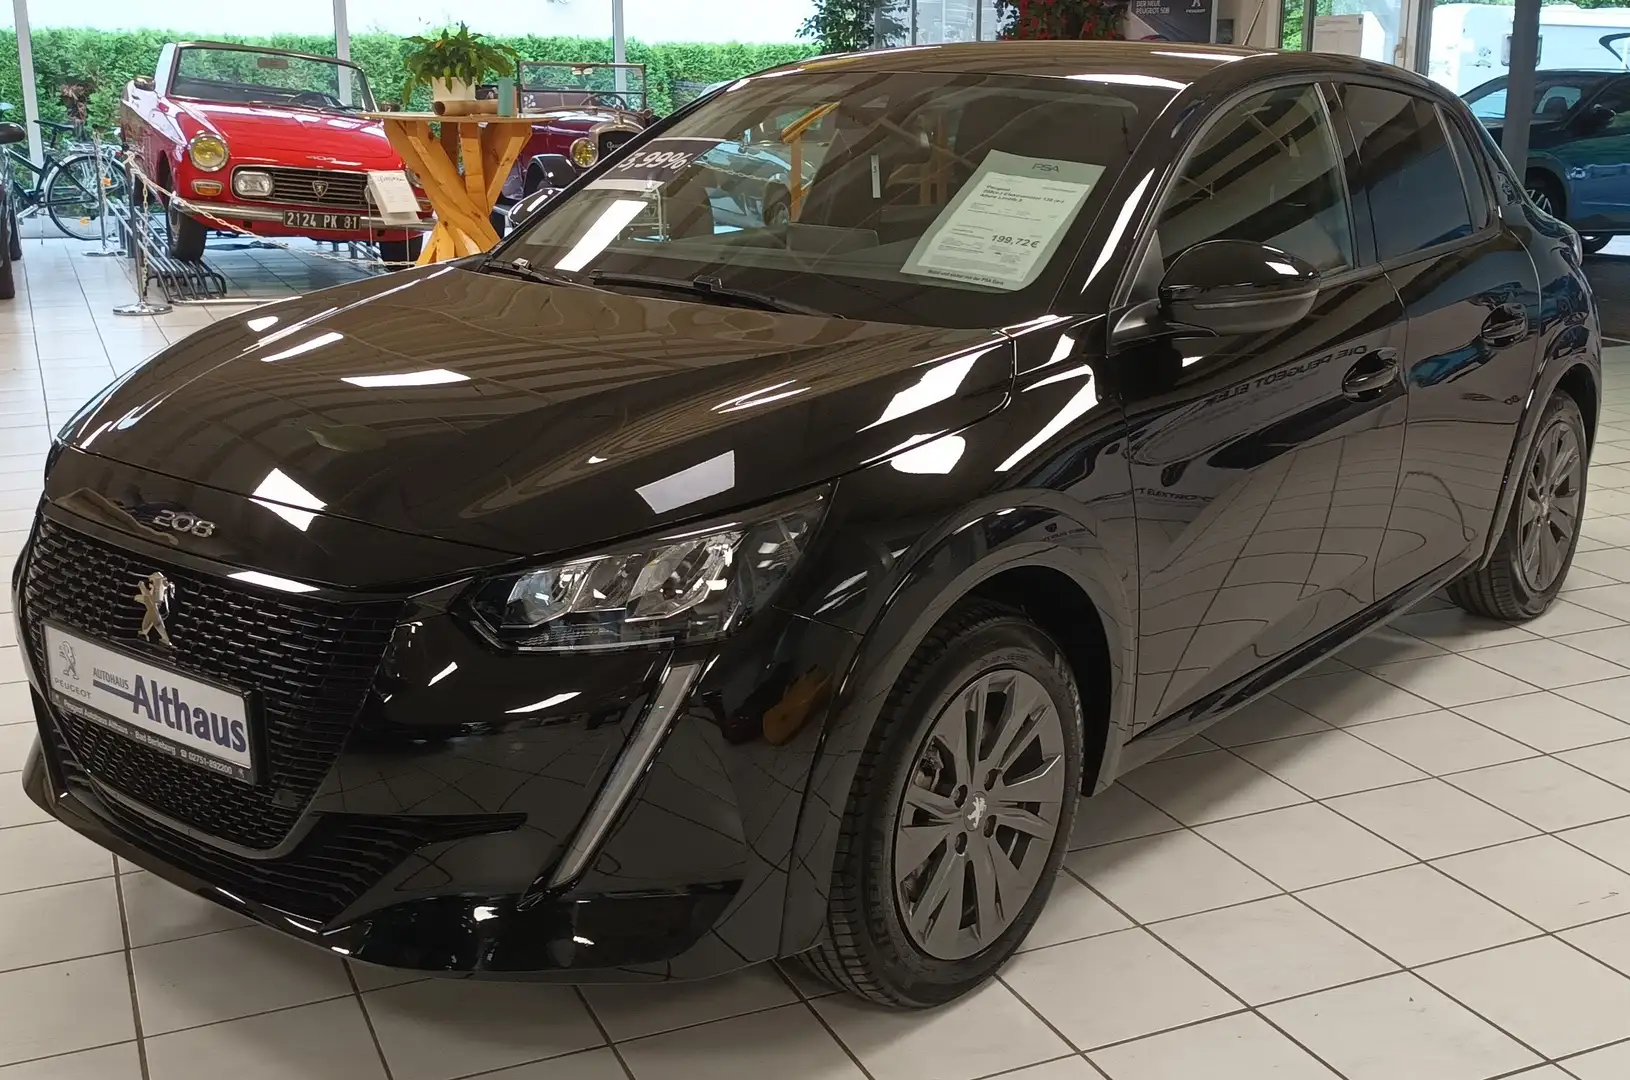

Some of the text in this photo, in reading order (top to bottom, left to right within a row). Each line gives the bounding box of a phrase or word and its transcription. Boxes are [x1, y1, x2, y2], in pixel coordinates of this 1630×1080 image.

[1031, 162, 1060, 173] PSA
[287, 212, 317, 227] 2124
[323, 215, 338, 228] PK
[152, 509, 216, 538] 208
[54, 677, 92, 699] PEUGEOT
[92, 667, 129, 689] AUTOHAUS
[132, 674, 247, 753] Althaus
[135, 730, 147, 741] Bad
